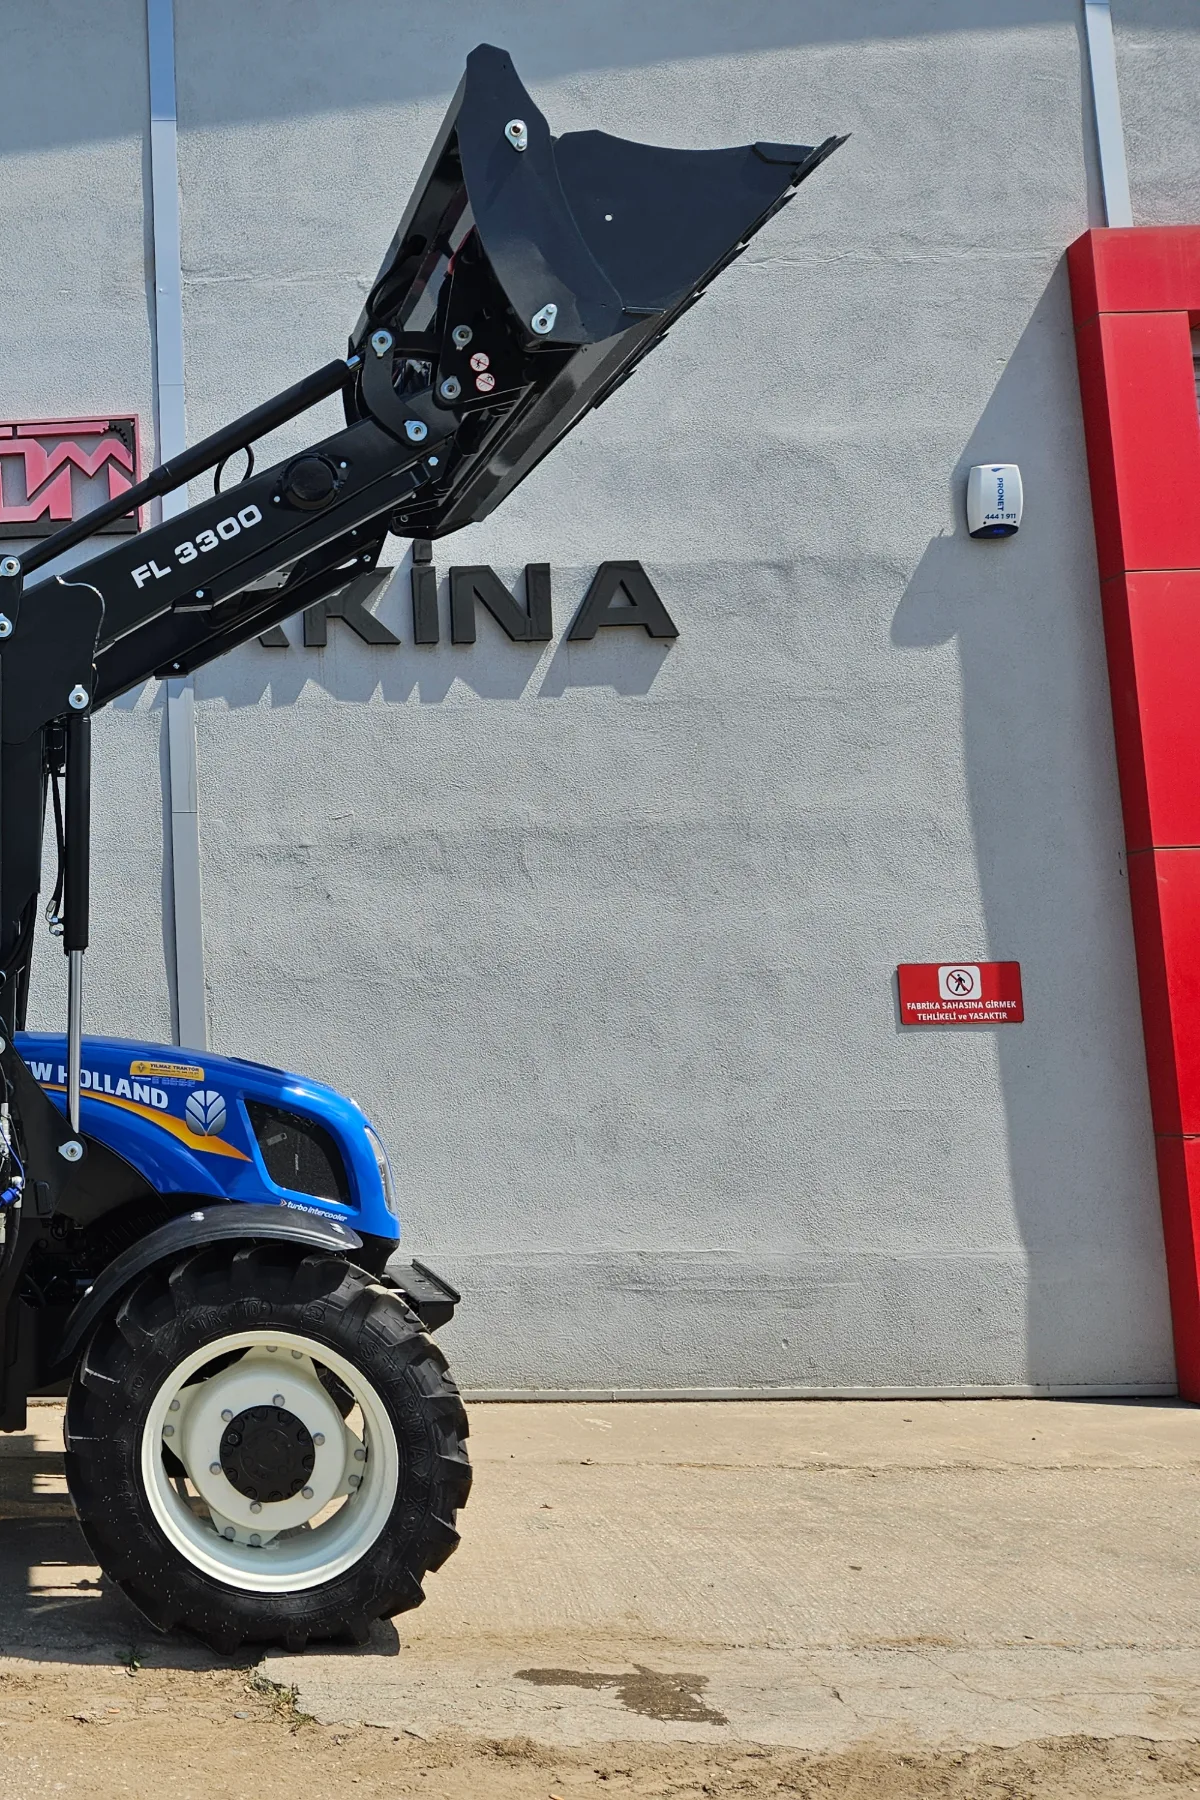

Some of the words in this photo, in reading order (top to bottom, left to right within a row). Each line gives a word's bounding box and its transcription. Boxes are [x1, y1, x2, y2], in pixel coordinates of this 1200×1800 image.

[997, 477, 1005, 511] PRONET
[131, 560, 172, 588] FL
[174, 504, 262, 564] 3300
[258, 539, 680, 647] KİNA
[907, 1001, 940, 1010] FABRİKA
[942, 1001, 983, 1010] SAHASINA
[985, 1000, 1017, 1009] GİRMEK
[917, 1011, 956, 1020] TEHLİKELİ
[969, 1012, 1008, 1020] YASAKTIR
[287, 1201, 308, 1212] turbo
[308, 1206, 348, 1222] intercooler
